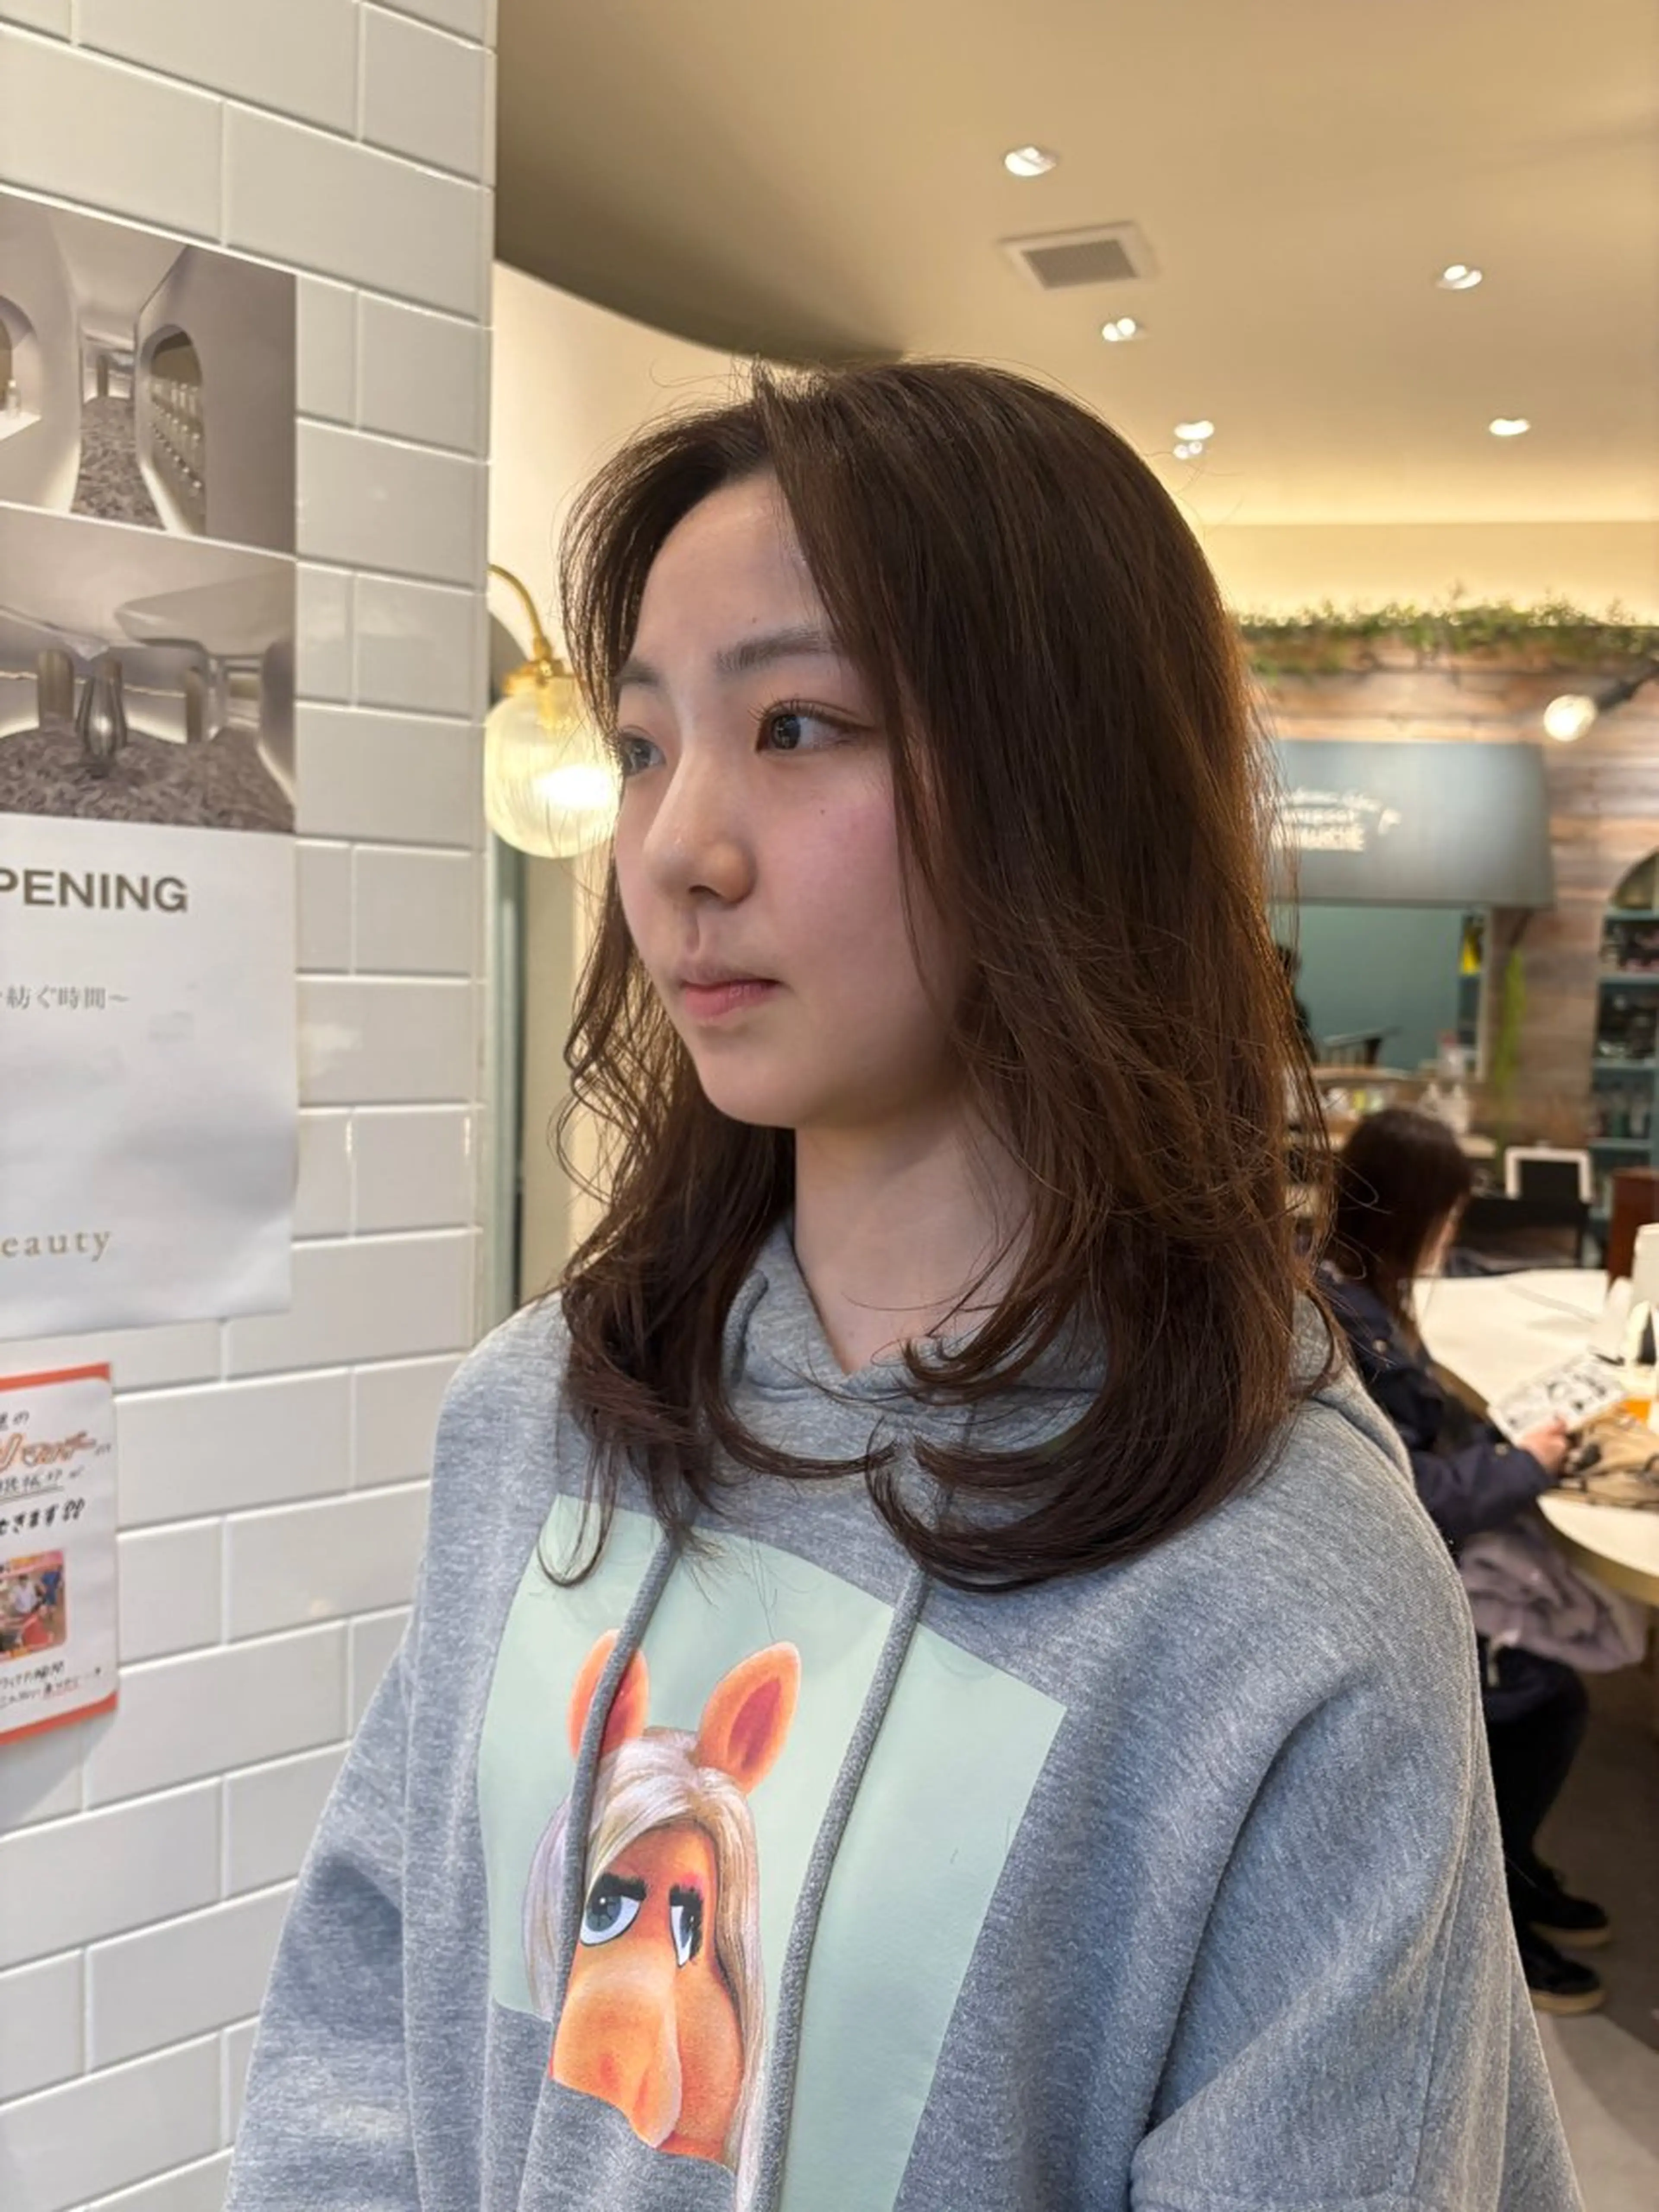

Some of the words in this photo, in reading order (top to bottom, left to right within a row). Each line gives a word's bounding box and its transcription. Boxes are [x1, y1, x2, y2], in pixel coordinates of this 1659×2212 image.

[0, 984, 130, 1009] 紡ぐ時間～
[1, 1230, 111, 1262] eauty
